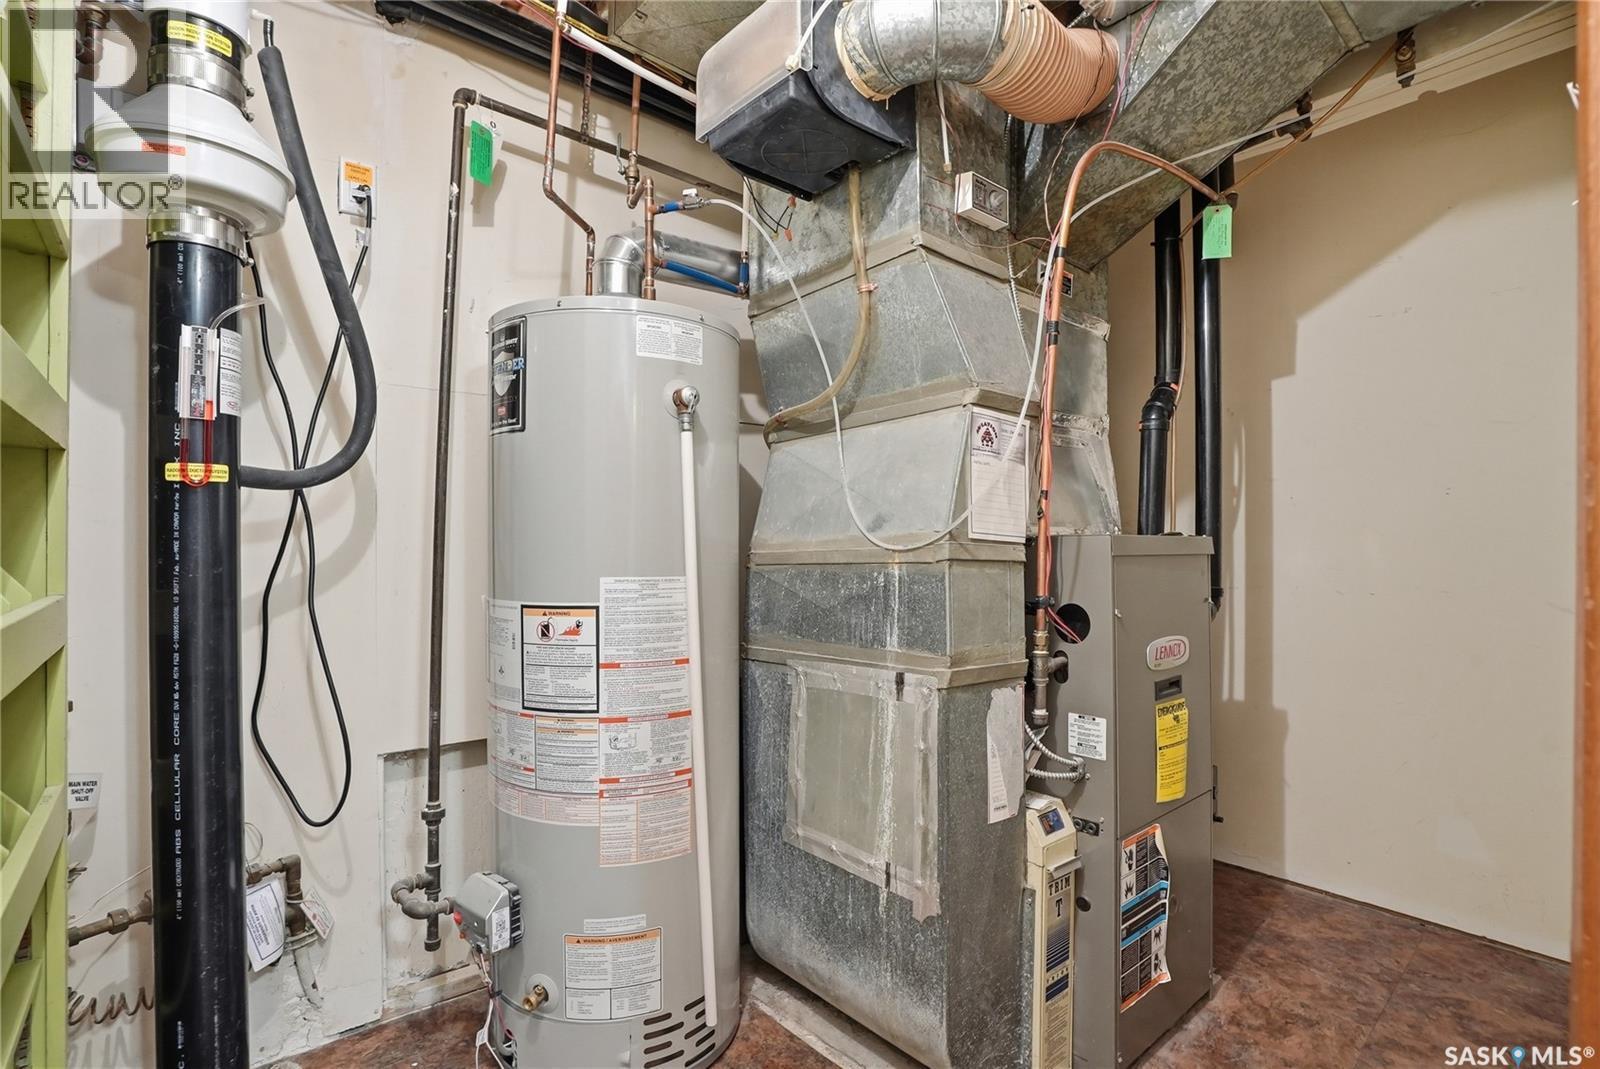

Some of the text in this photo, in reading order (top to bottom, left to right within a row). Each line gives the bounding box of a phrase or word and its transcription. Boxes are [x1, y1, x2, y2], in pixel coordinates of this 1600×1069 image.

[1155, 642, 1182, 661] LENNOX
[173, 712, 181, 746] CORE
[173, 753, 182, 821] CELLULAR
[1056, 898, 1063, 918] T
